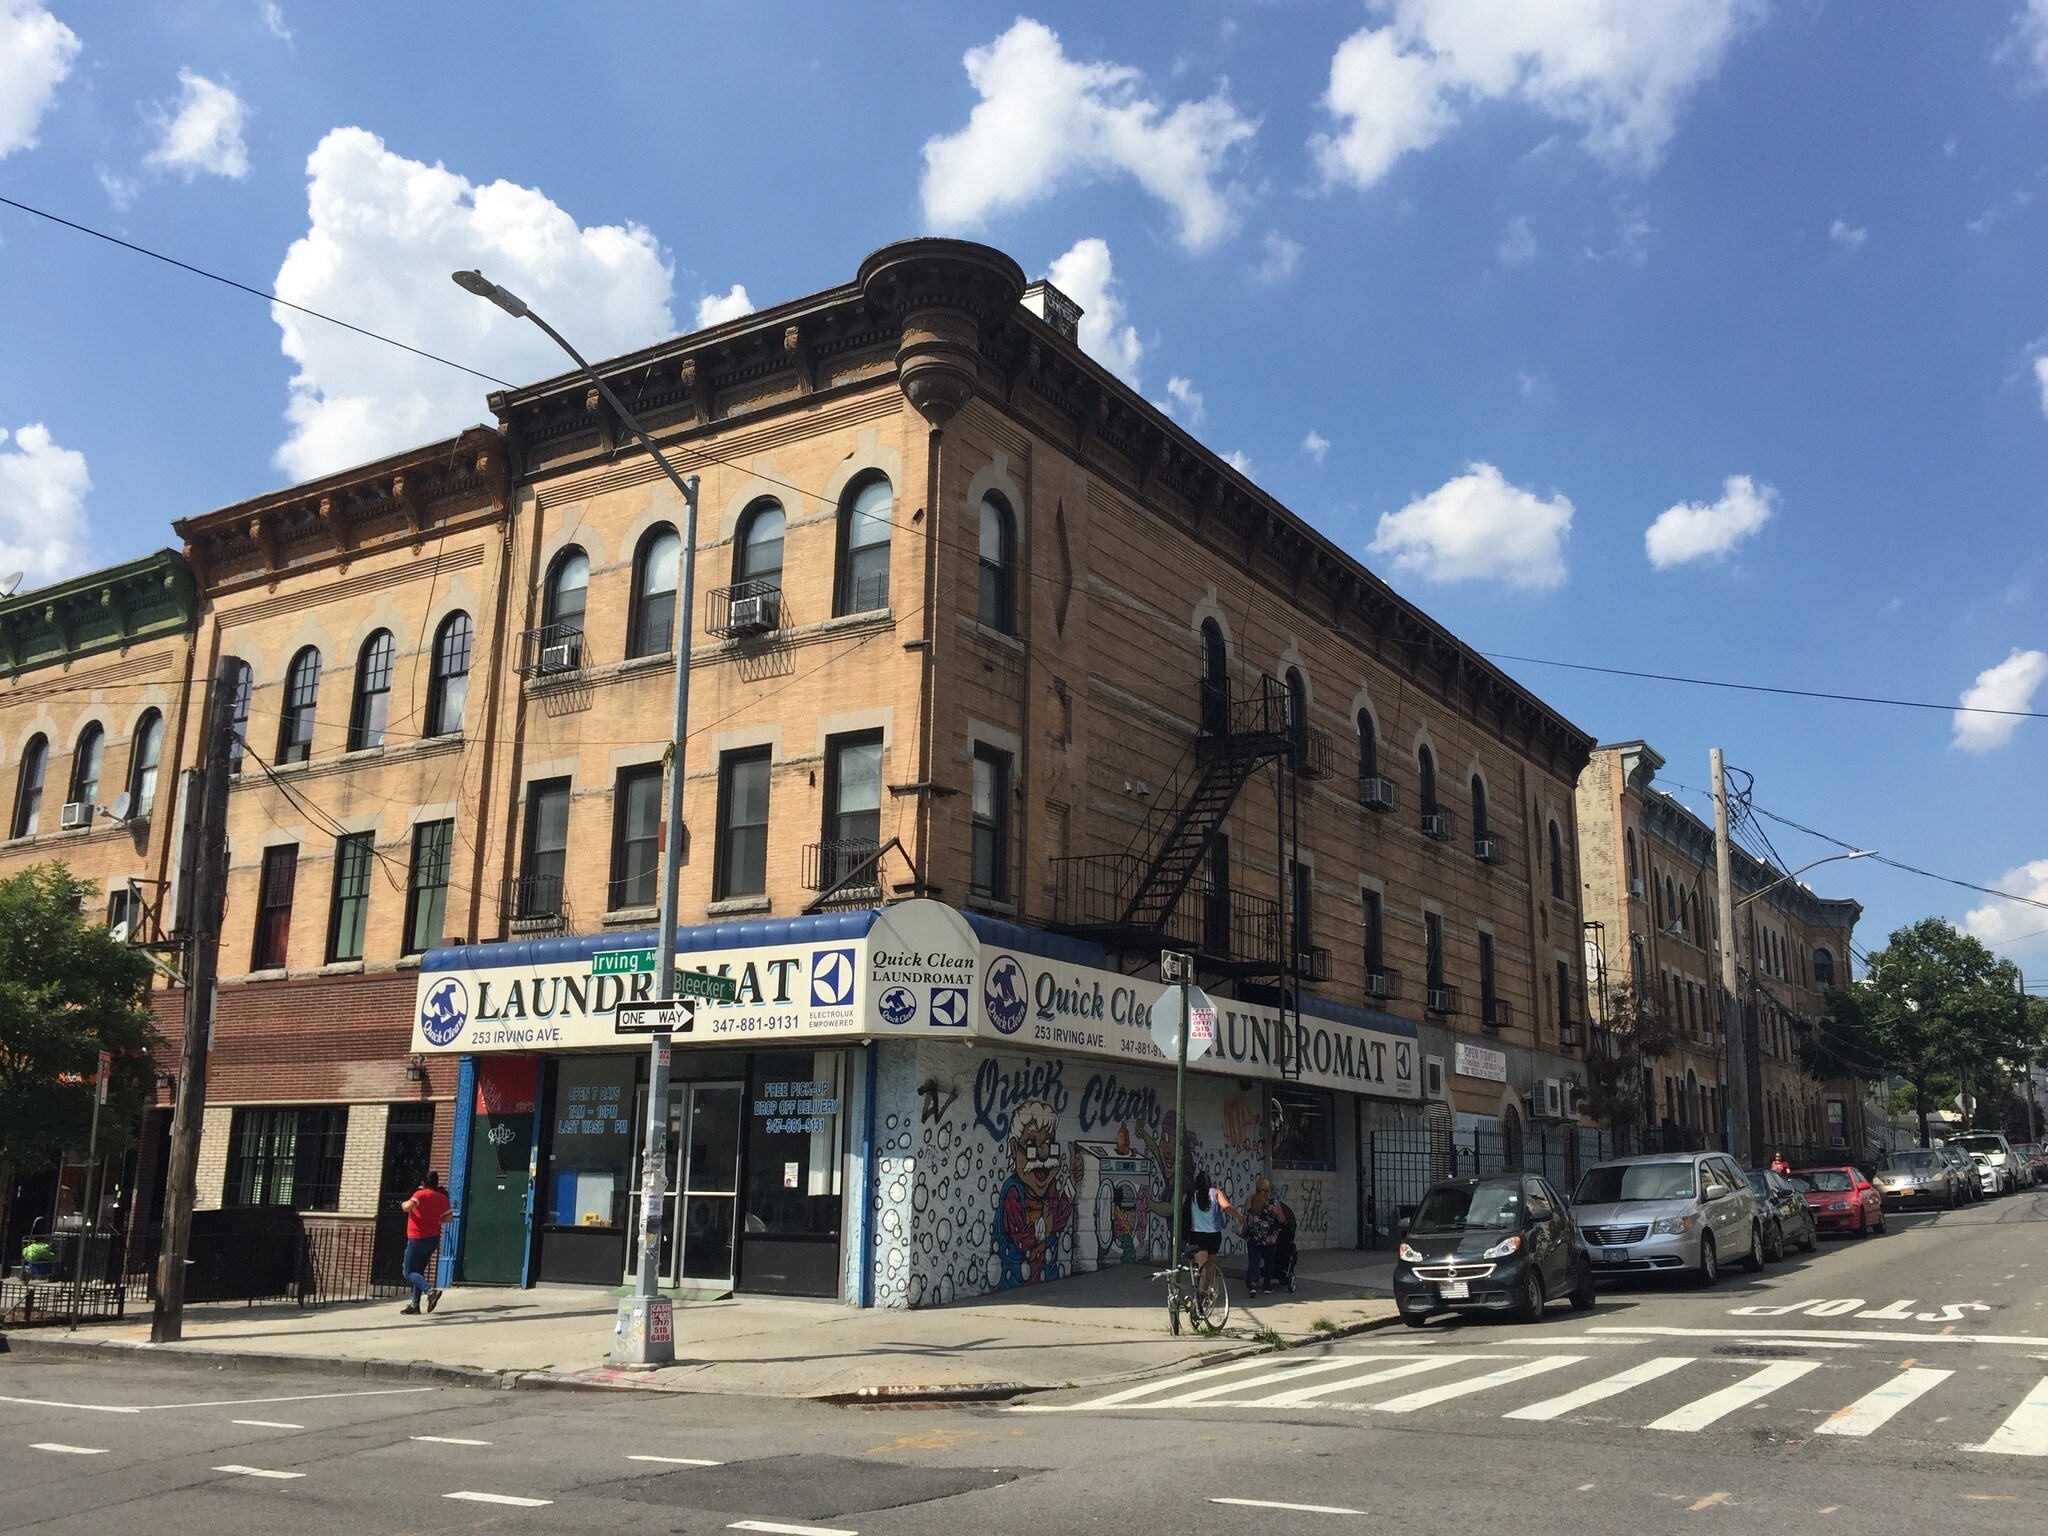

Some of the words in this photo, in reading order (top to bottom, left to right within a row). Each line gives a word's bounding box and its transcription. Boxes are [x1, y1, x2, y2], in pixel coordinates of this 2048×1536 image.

[593, 953, 639, 971] Irving
[873, 951, 922, 968] Quick
[927, 952, 974, 968] Clean
[674, 973, 725, 998] Bleecker
[729, 982, 736, 992] St
[872, 971, 974, 985] LAUNDROMAT
[1035, 971, 1104, 1021] Quick
[1110, 987, 1152, 1029] Clea
[622, 1012, 645, 1024] ONE
[658, 1010, 684, 1023] WAY
[809, 1010, 854, 1019] ELECTROLUX
[988, 1002, 1007, 1030] Quick
[1007, 1005, 1026, 1031] Clean
[423, 1020, 442, 1043] Quick
[443, 1017, 464, 1042] Clean
[712, 1015, 799, 1033] 347-881-9131
[808, 1019, 854, 1028] EMPOWERED
[472, 1032, 491, 1045] 253
[494, 1029, 533, 1043] IRVING
[536, 1028, 563, 1042] AVE.
[1035, 1025, 1051, 1040] 253
[1053, 1028, 1085, 1045] IRVING
[1086, 1033, 1106, 1048] AVE.
[568, 1086, 590, 1100] OPEN
[592, 1086, 598, 1100] 7
[600, 1086, 620, 1100] DAYS
[764, 1083, 788, 1097] FREE
[791, 1081, 829, 1097] PICK-UP
[754, 1100, 777, 1115] DROP
[779, 1100, 796, 1115] OFF
[797, 1098, 838, 1114] DELIVERY
[973, 1058, 1068, 1142] Quick
[1078, 1073, 1161, 1132] Clean
[568, 1105, 585, 1118] 7AM
[597, 1105, 618, 1118] 10PM
[558, 1120, 579, 1134] LAST
[581, 1120, 604, 1134] WASH
[614, 1120, 628, 1134] PM
[766, 1118, 825, 1134] 347-881-9131
[1726, 1298, 1991, 1322] STOP
[650, 1334, 670, 1342] 6499
[654, 1326, 668, 1334] 515
